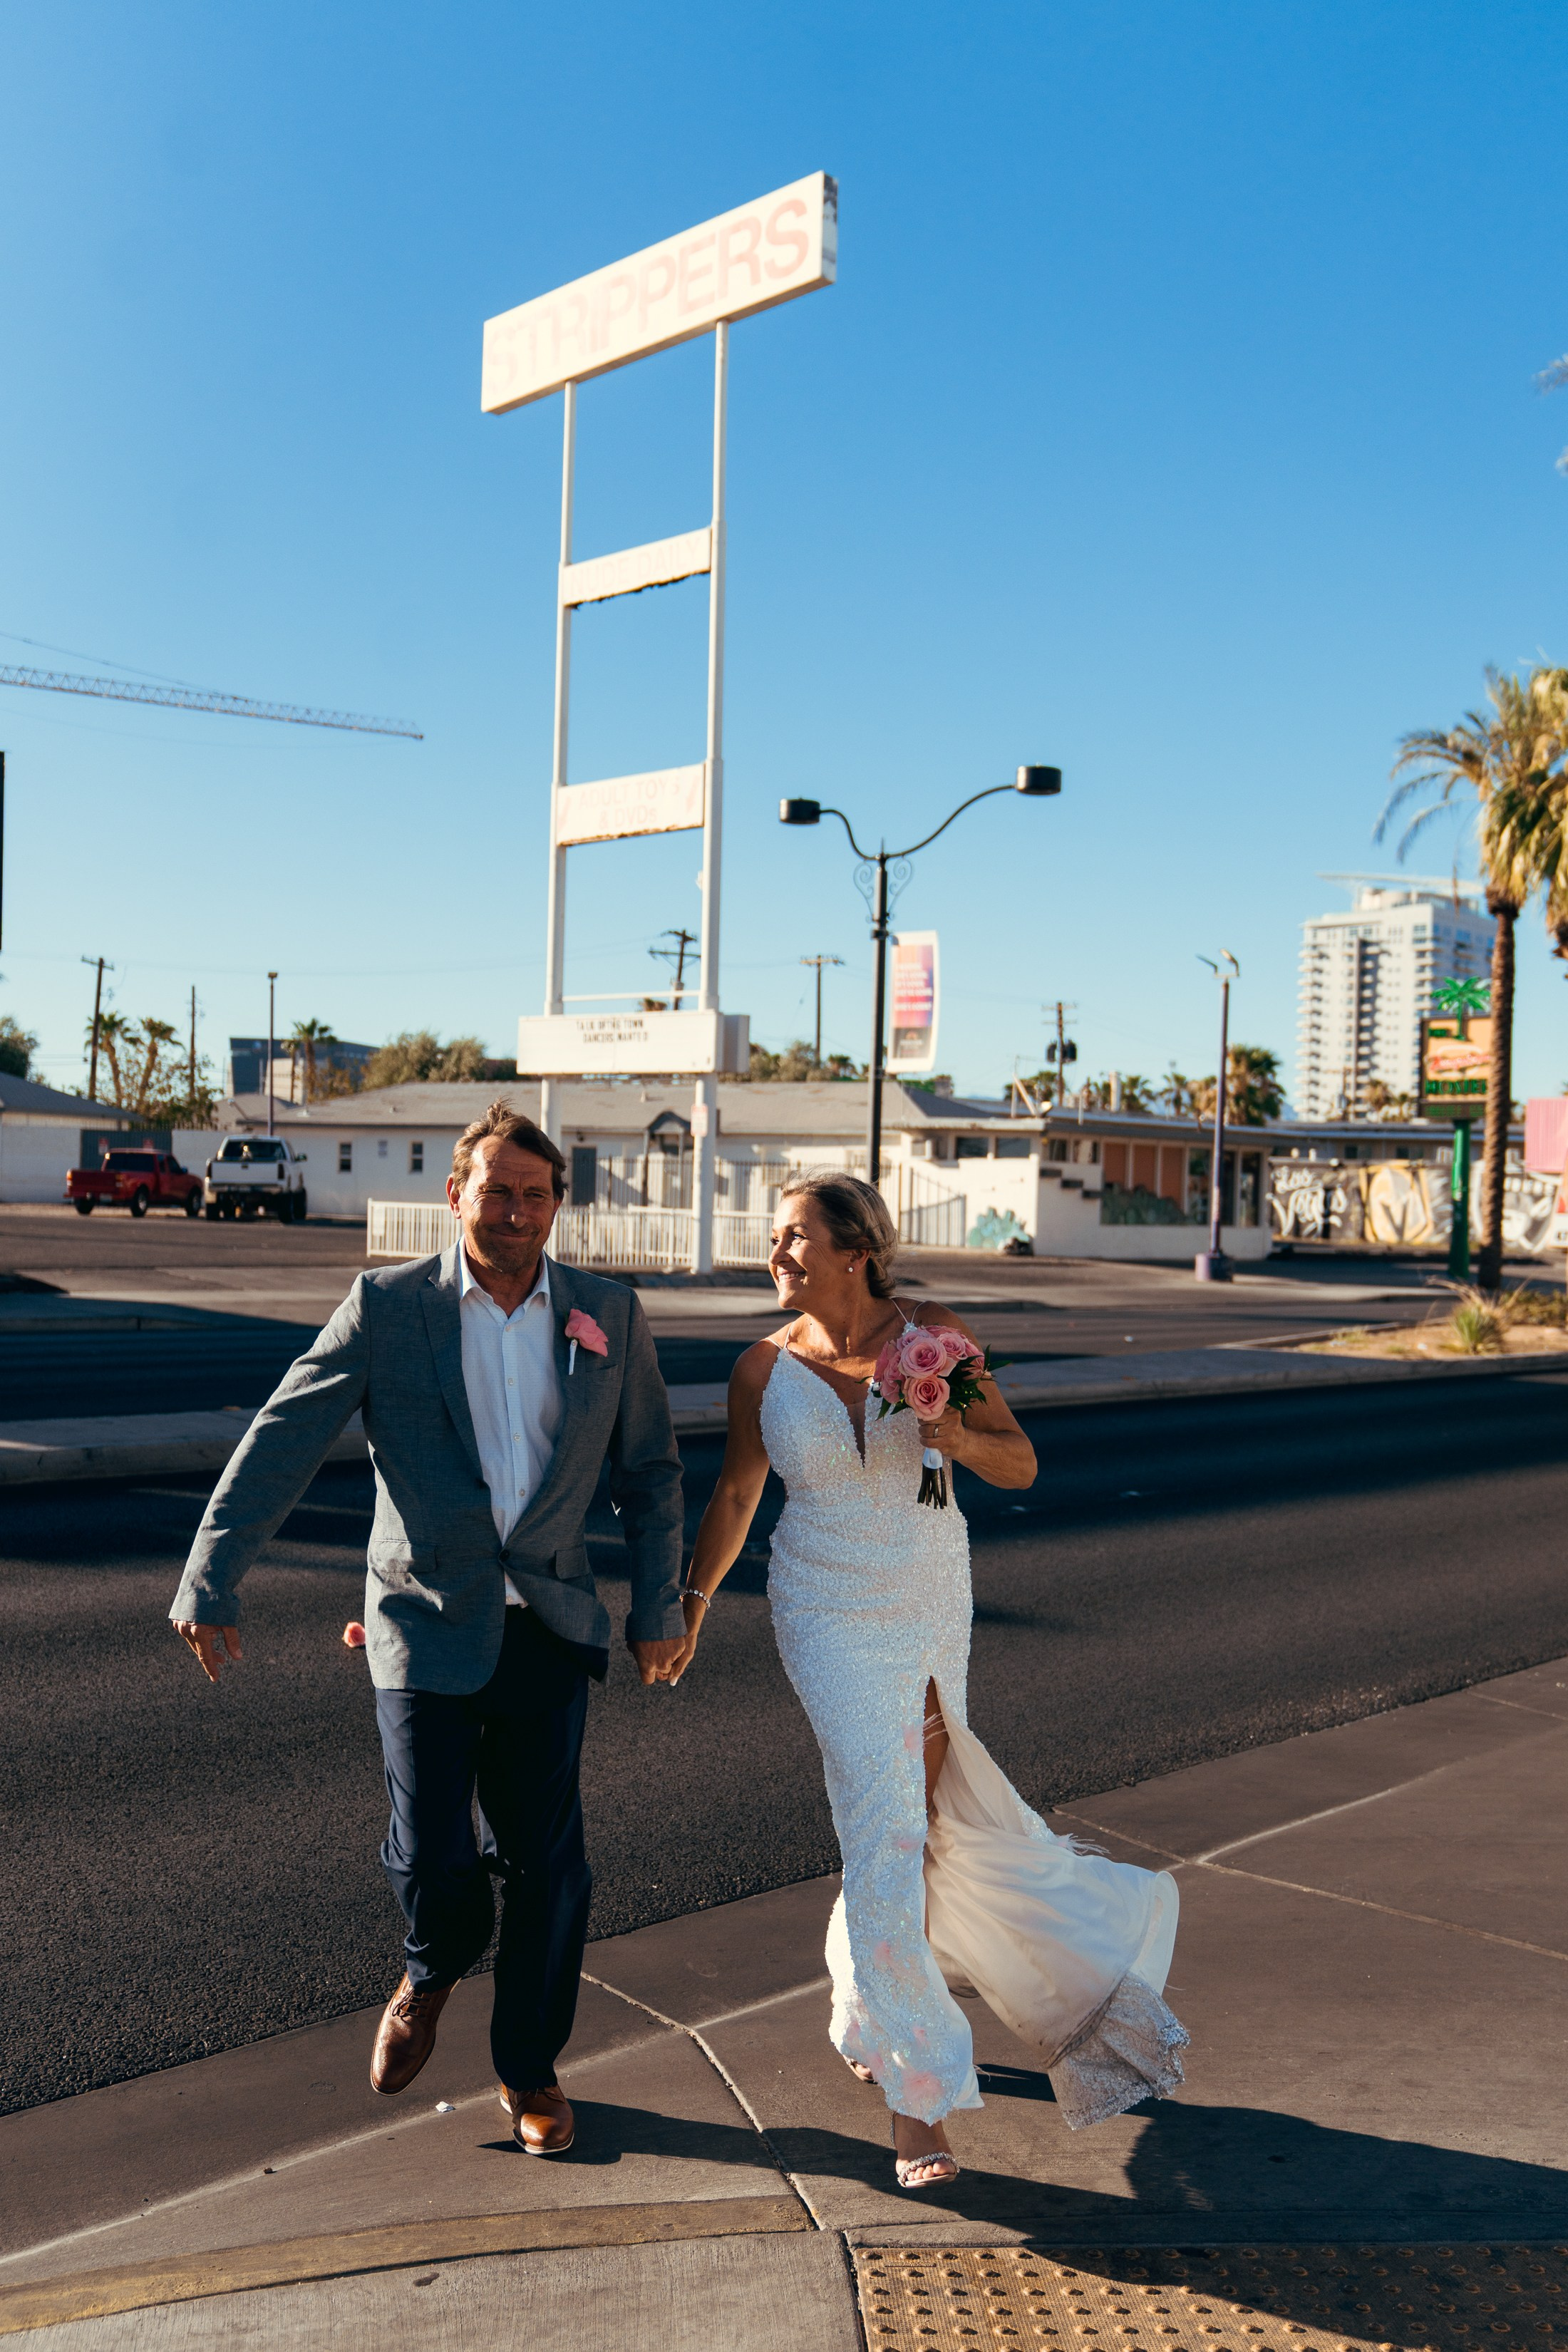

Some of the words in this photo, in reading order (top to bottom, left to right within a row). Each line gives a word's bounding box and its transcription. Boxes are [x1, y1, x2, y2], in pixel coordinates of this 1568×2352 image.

[485, 198, 810, 396] STRIPPERS
[570, 556, 630, 597] NUDE
[638, 537, 701, 579] DAILY
[578, 783, 633, 810] ADULT
[624, 1019, 644, 1028] TOWN
